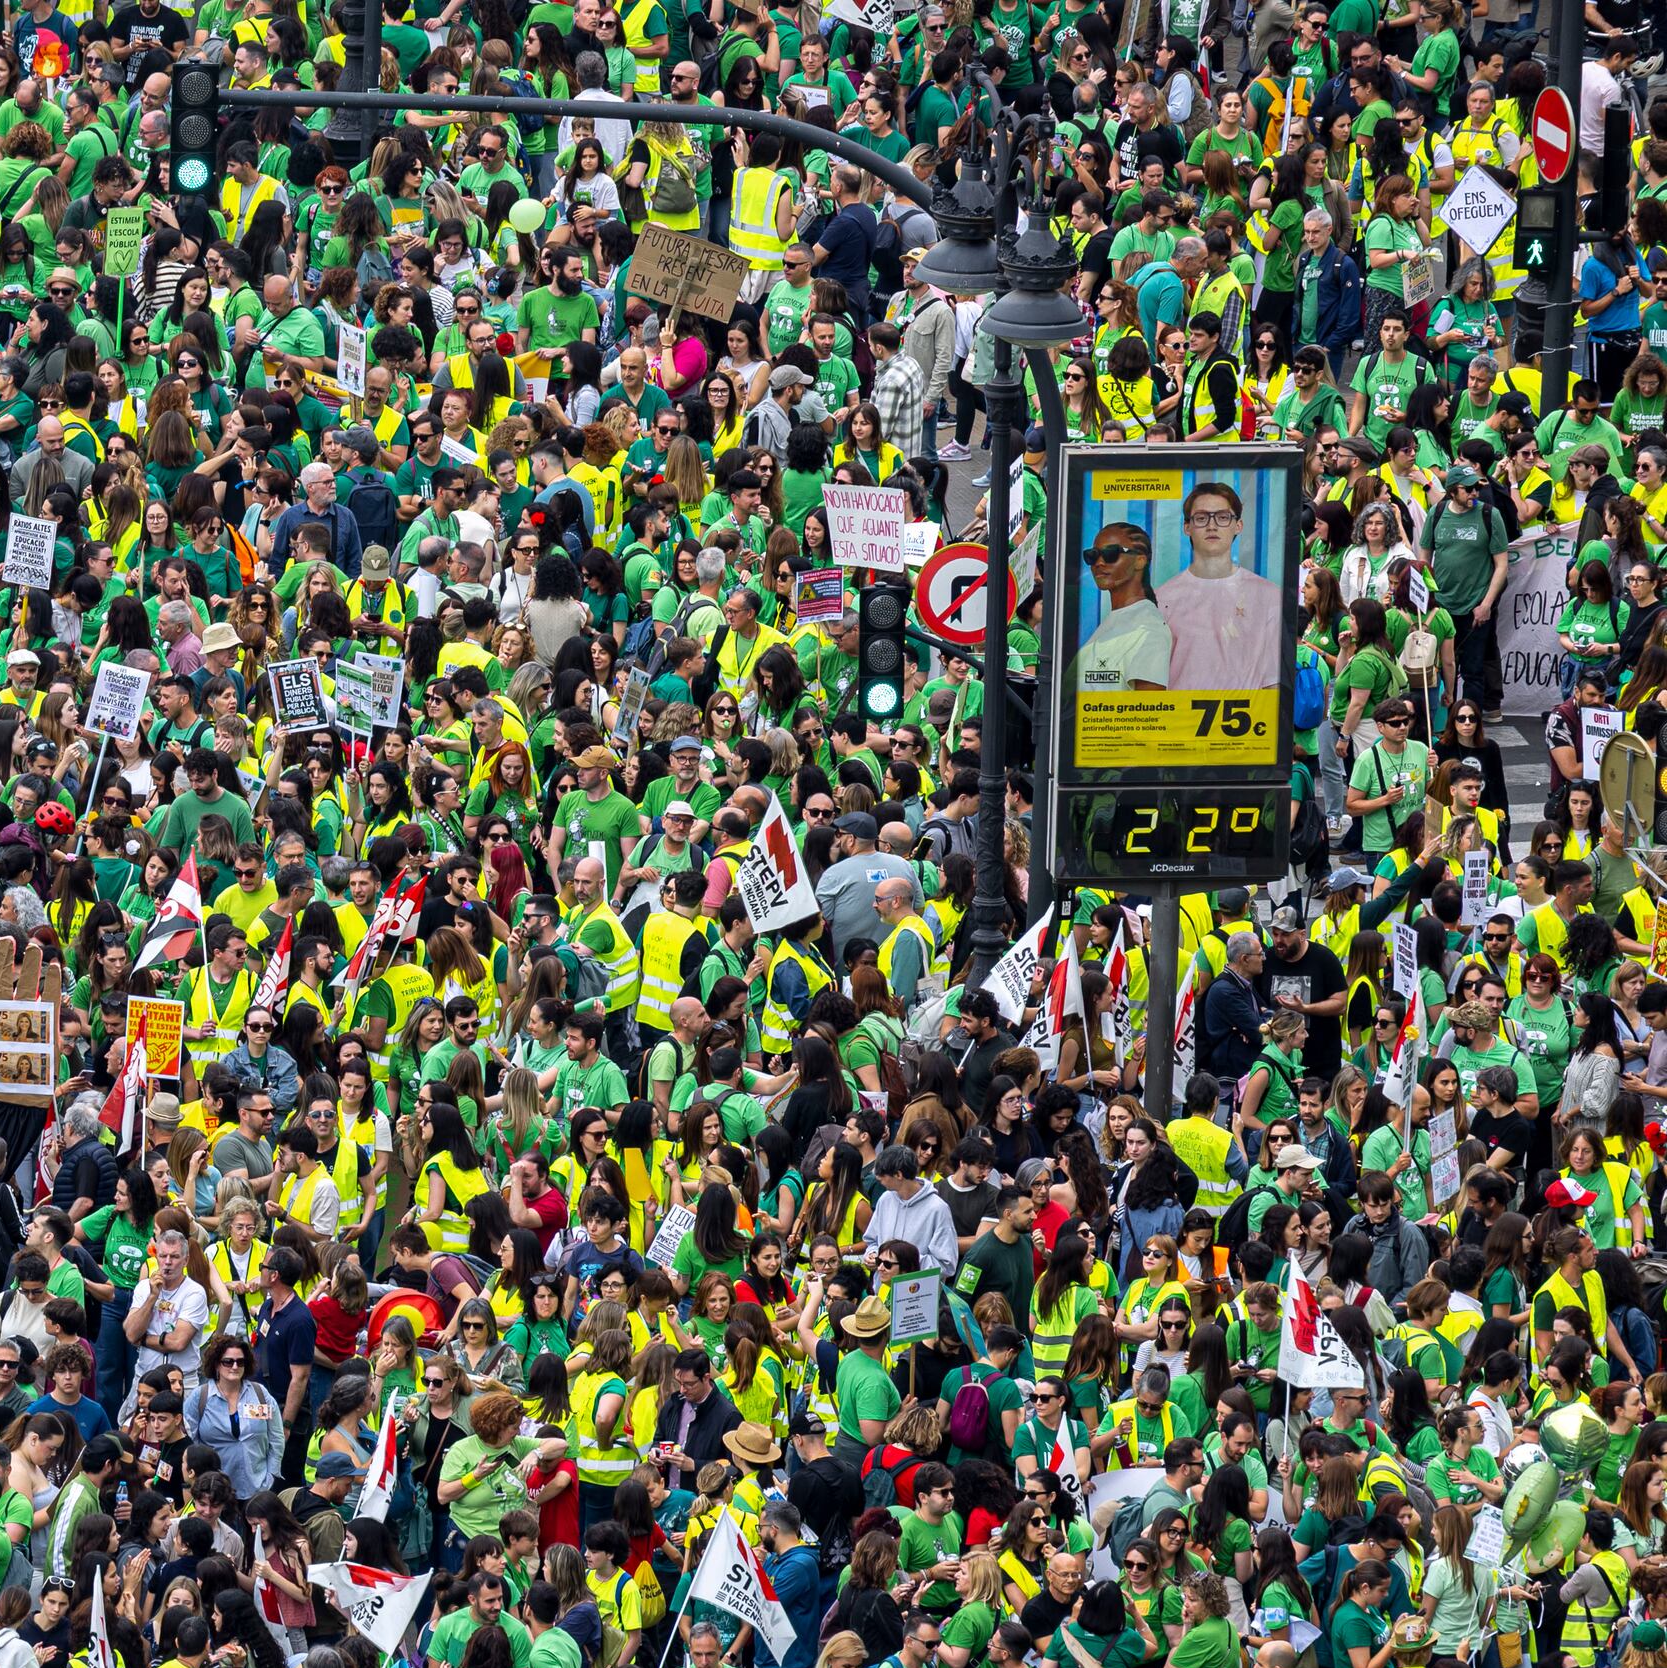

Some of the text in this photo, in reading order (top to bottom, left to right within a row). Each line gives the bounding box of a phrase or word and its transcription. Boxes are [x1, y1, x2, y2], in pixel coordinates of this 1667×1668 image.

[1464, 191, 1486, 205] ENS
[1449, 204, 1504, 222] OFEGUEM
[110, 216, 140, 225] ESTIMEM
[1104, 484, 1170, 495] UNIVERSITARIA
[825, 491, 840, 509] NO
[863, 493, 903, 515] VOCACIÓ
[837, 516, 900, 539] QUE AGUANTE
[833, 541, 900, 565] ESTA SITUACIÓ
[1085, 672, 1120, 682] MUNICH
[1083, 703, 1114, 713] Gafas
[1116, 703, 1175, 716] graduadas
[1150, 864, 1194, 873] JCDecaux
